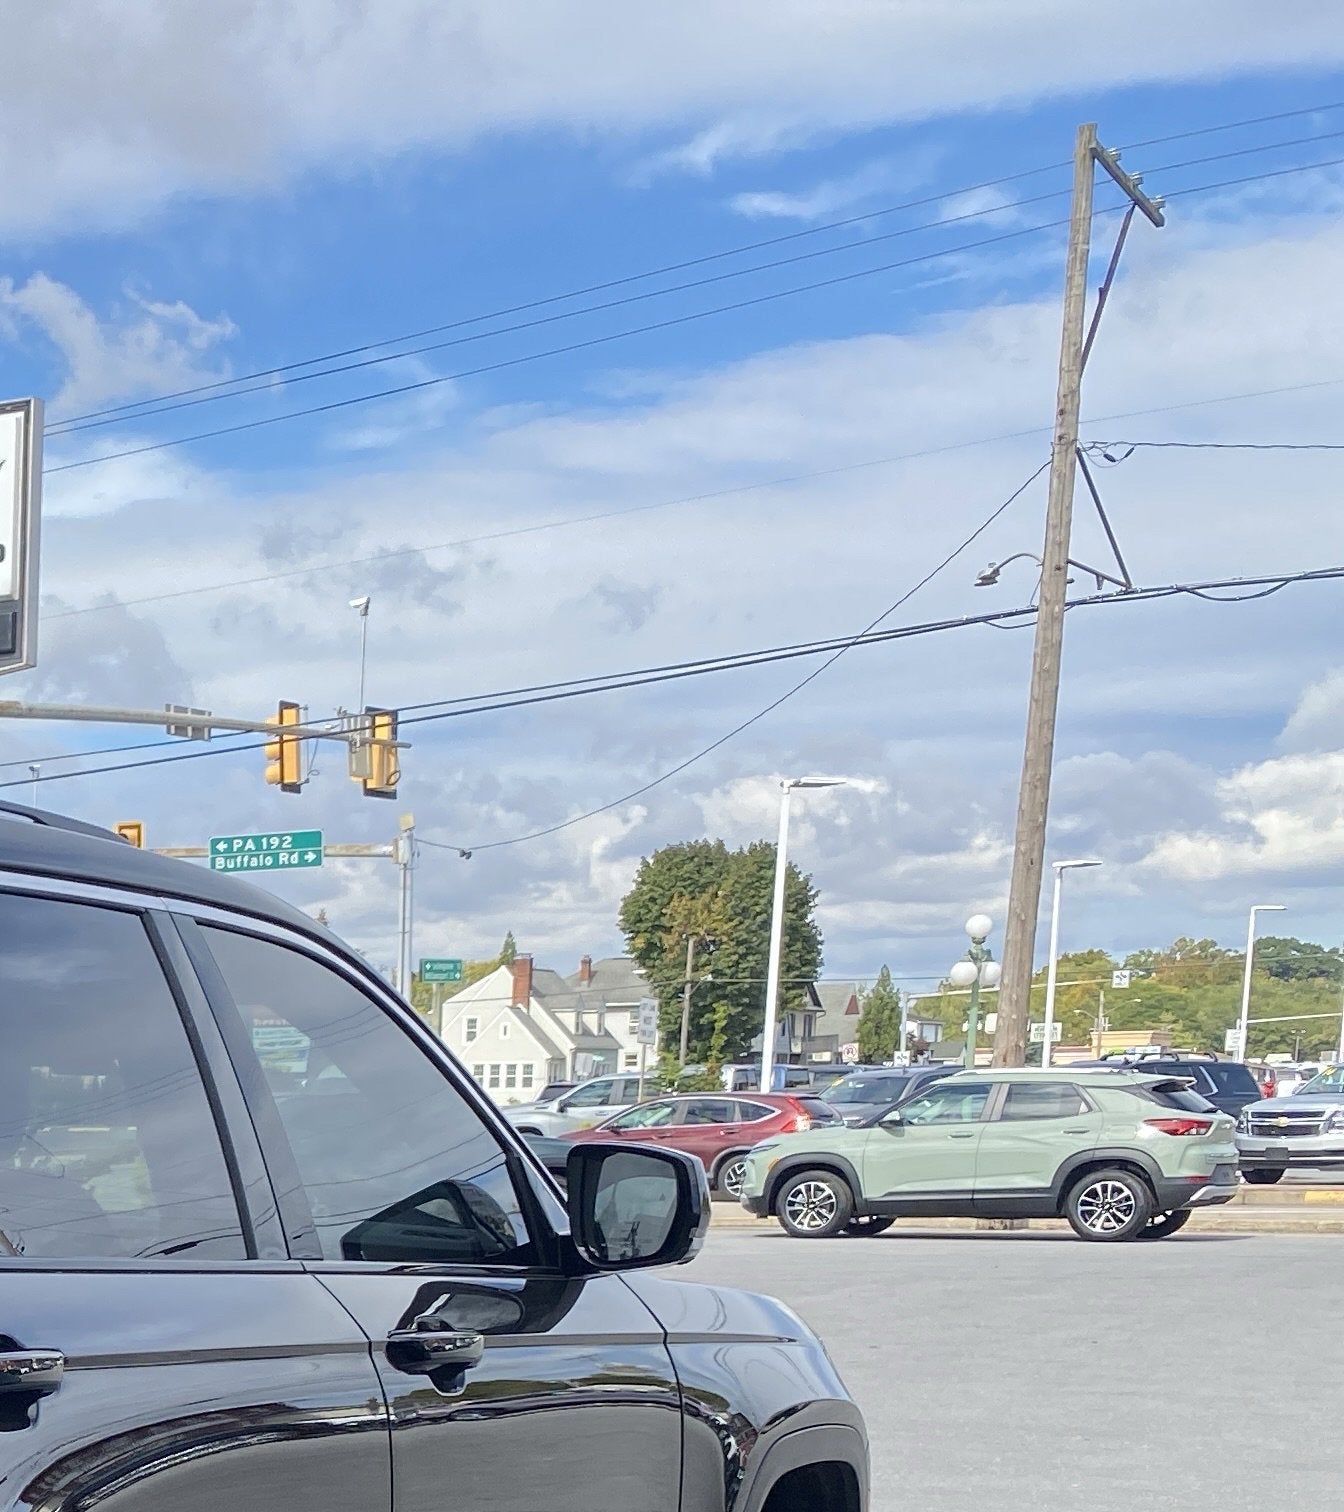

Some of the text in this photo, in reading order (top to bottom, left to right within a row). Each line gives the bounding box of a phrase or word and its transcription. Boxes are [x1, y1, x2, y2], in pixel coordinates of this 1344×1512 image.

[232, 835, 293, 852] PA 192
[215, 852, 299, 870] Buffalo Rd
